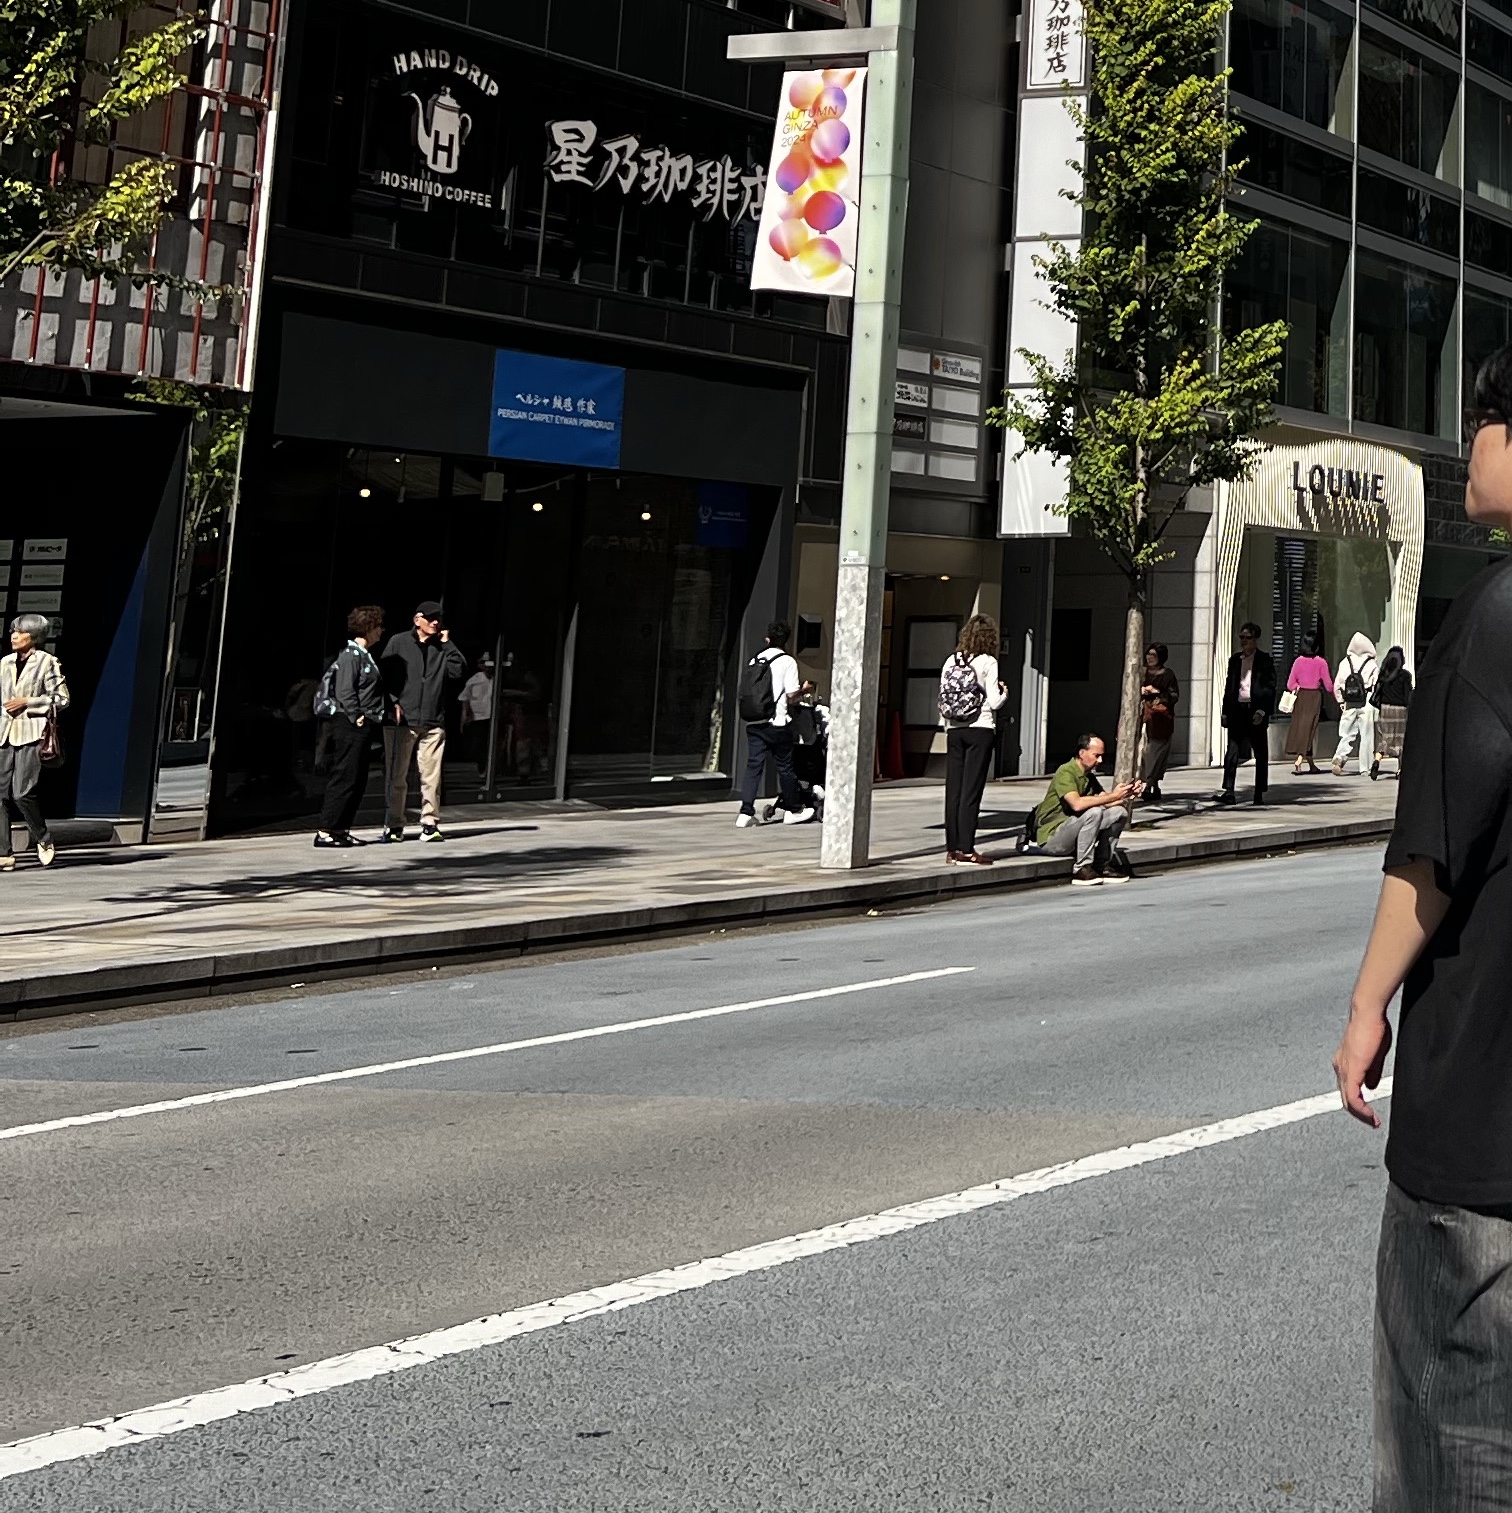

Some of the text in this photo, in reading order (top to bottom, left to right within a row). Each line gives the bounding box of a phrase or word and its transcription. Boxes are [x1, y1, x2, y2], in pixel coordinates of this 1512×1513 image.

[393, 49, 499, 97] HAND DRIP
[784, 105, 838, 121] AUTUMN
[782, 119, 819, 135] GINZA
[781, 134, 806, 148] 2024
[380, 170, 492, 208] HOSHINO COFFEE
[497, 407, 528, 420] PERSIAN
[527, 411, 554, 424] CARPET
[1293, 461, 1385, 503] LOUNIE
